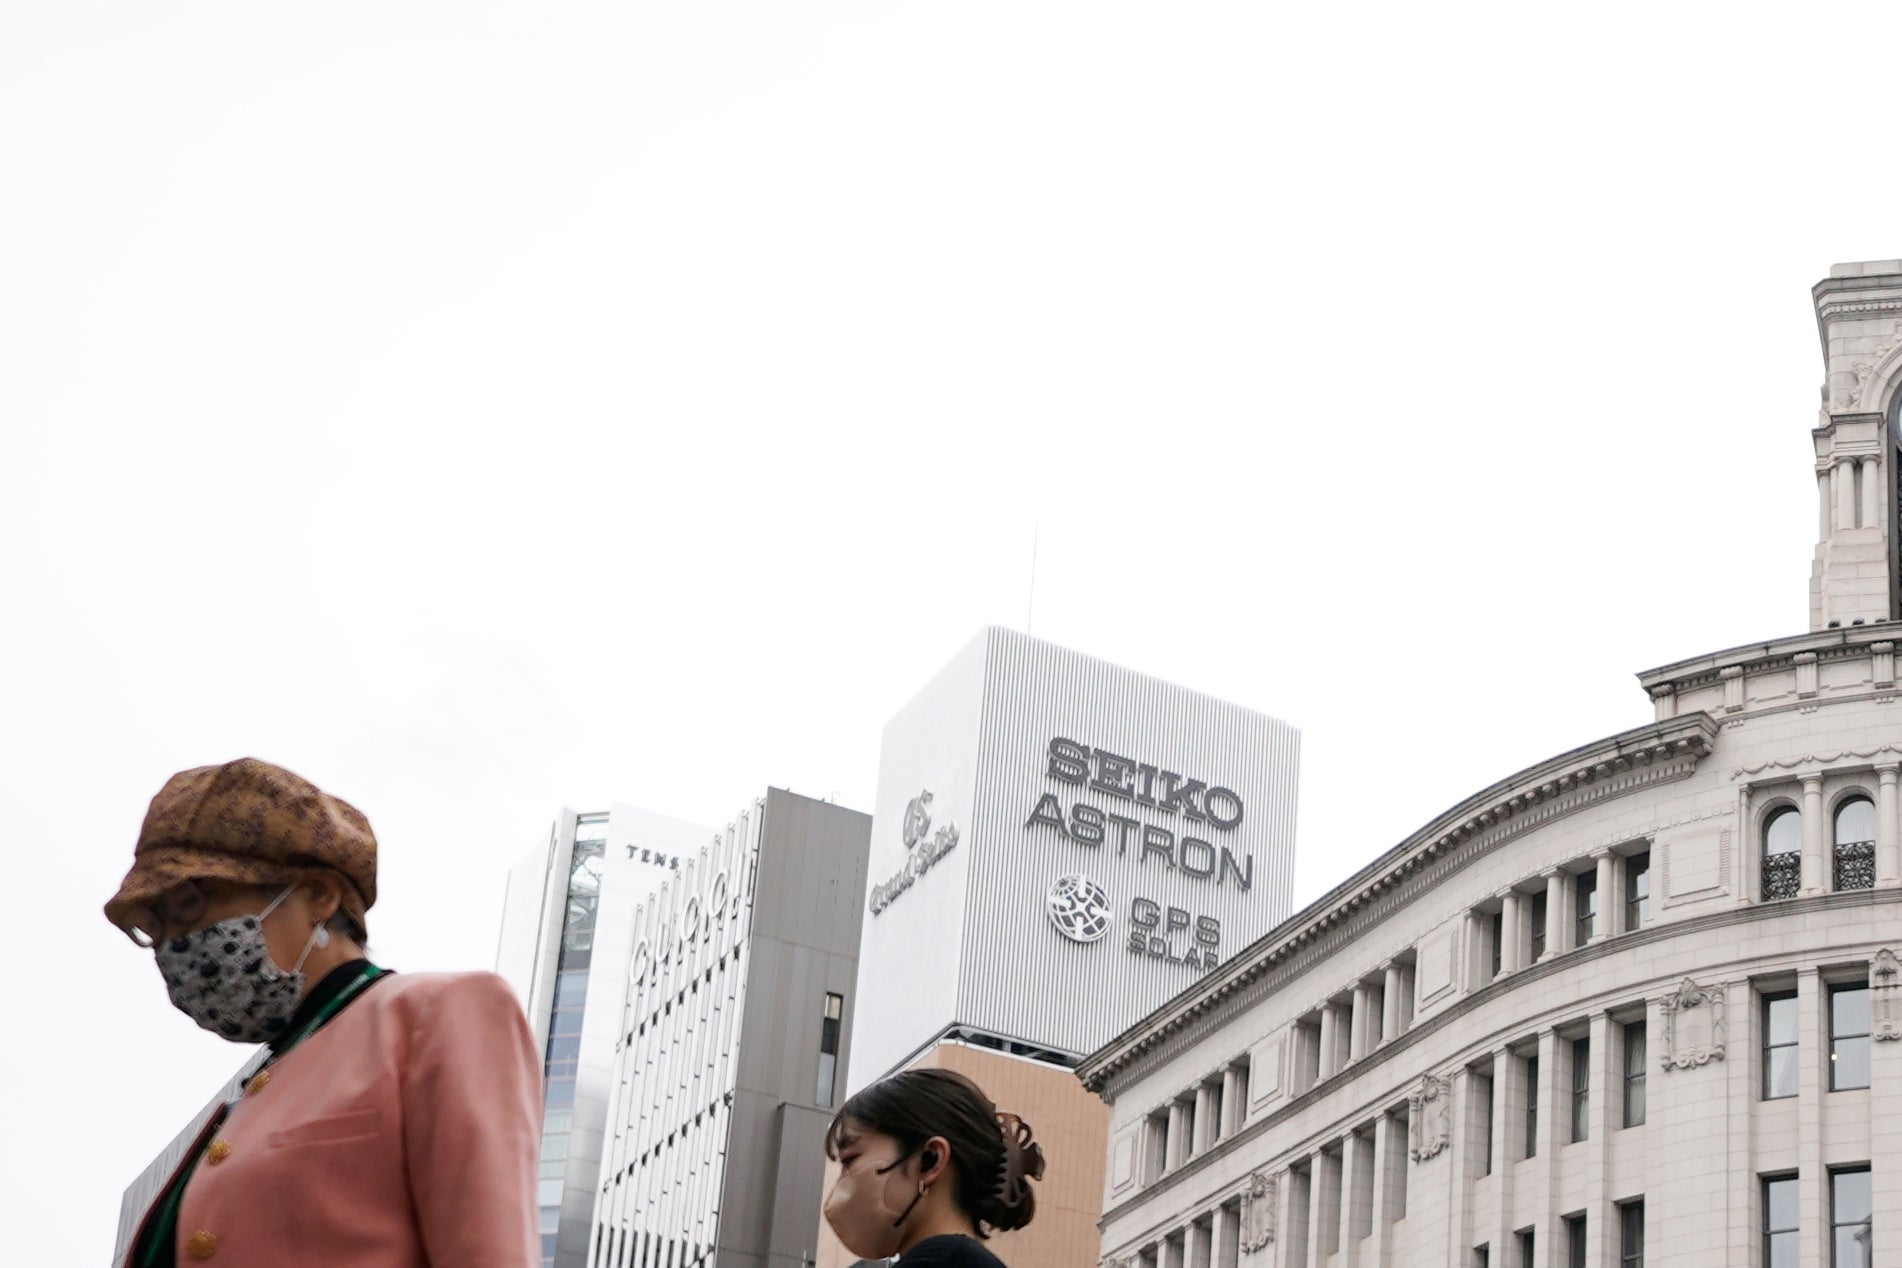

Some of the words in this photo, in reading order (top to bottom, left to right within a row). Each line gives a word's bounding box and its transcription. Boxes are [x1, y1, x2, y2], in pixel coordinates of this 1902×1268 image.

[1047, 736, 1244, 831] SEIKO
[1023, 791, 1253, 893] ASTRON
[1127, 929, 1219, 970] SOLAR
[1130, 895, 1221, 947] GPS
